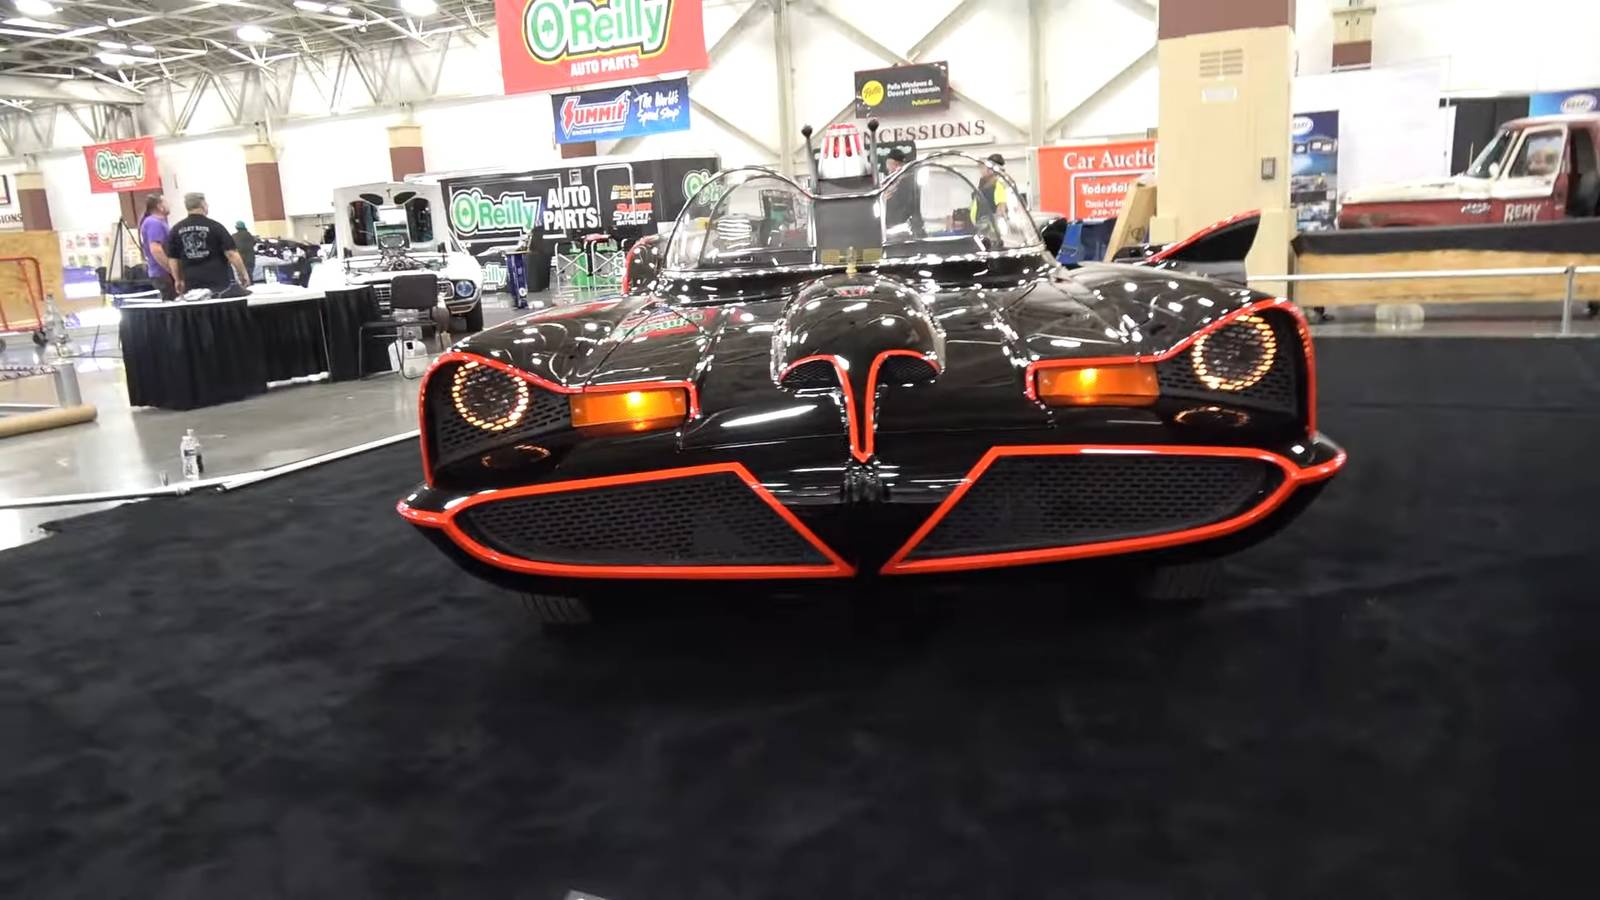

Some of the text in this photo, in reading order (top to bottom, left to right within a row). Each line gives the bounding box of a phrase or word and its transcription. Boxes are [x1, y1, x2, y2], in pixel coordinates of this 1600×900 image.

[530, 0, 663, 52] O'Reilly
[570, 54, 639, 77] AUTO PARTS
[634, 92, 653, 111] The
[863, 119, 986, 143] NCESSIONS
[97, 152, 142, 178] O'Reilly
[1063, 152, 1095, 171] Car
[546, 185, 591, 209] AUTO
[1081, 182, 1129, 195] YoderSal
[0, 213, 23, 224] IONS
[453, 190, 537, 232] O'Reilly
[543, 208, 598, 231] PARTS
[612, 210, 653, 221] START
[1504, 202, 1541, 224] REMY
